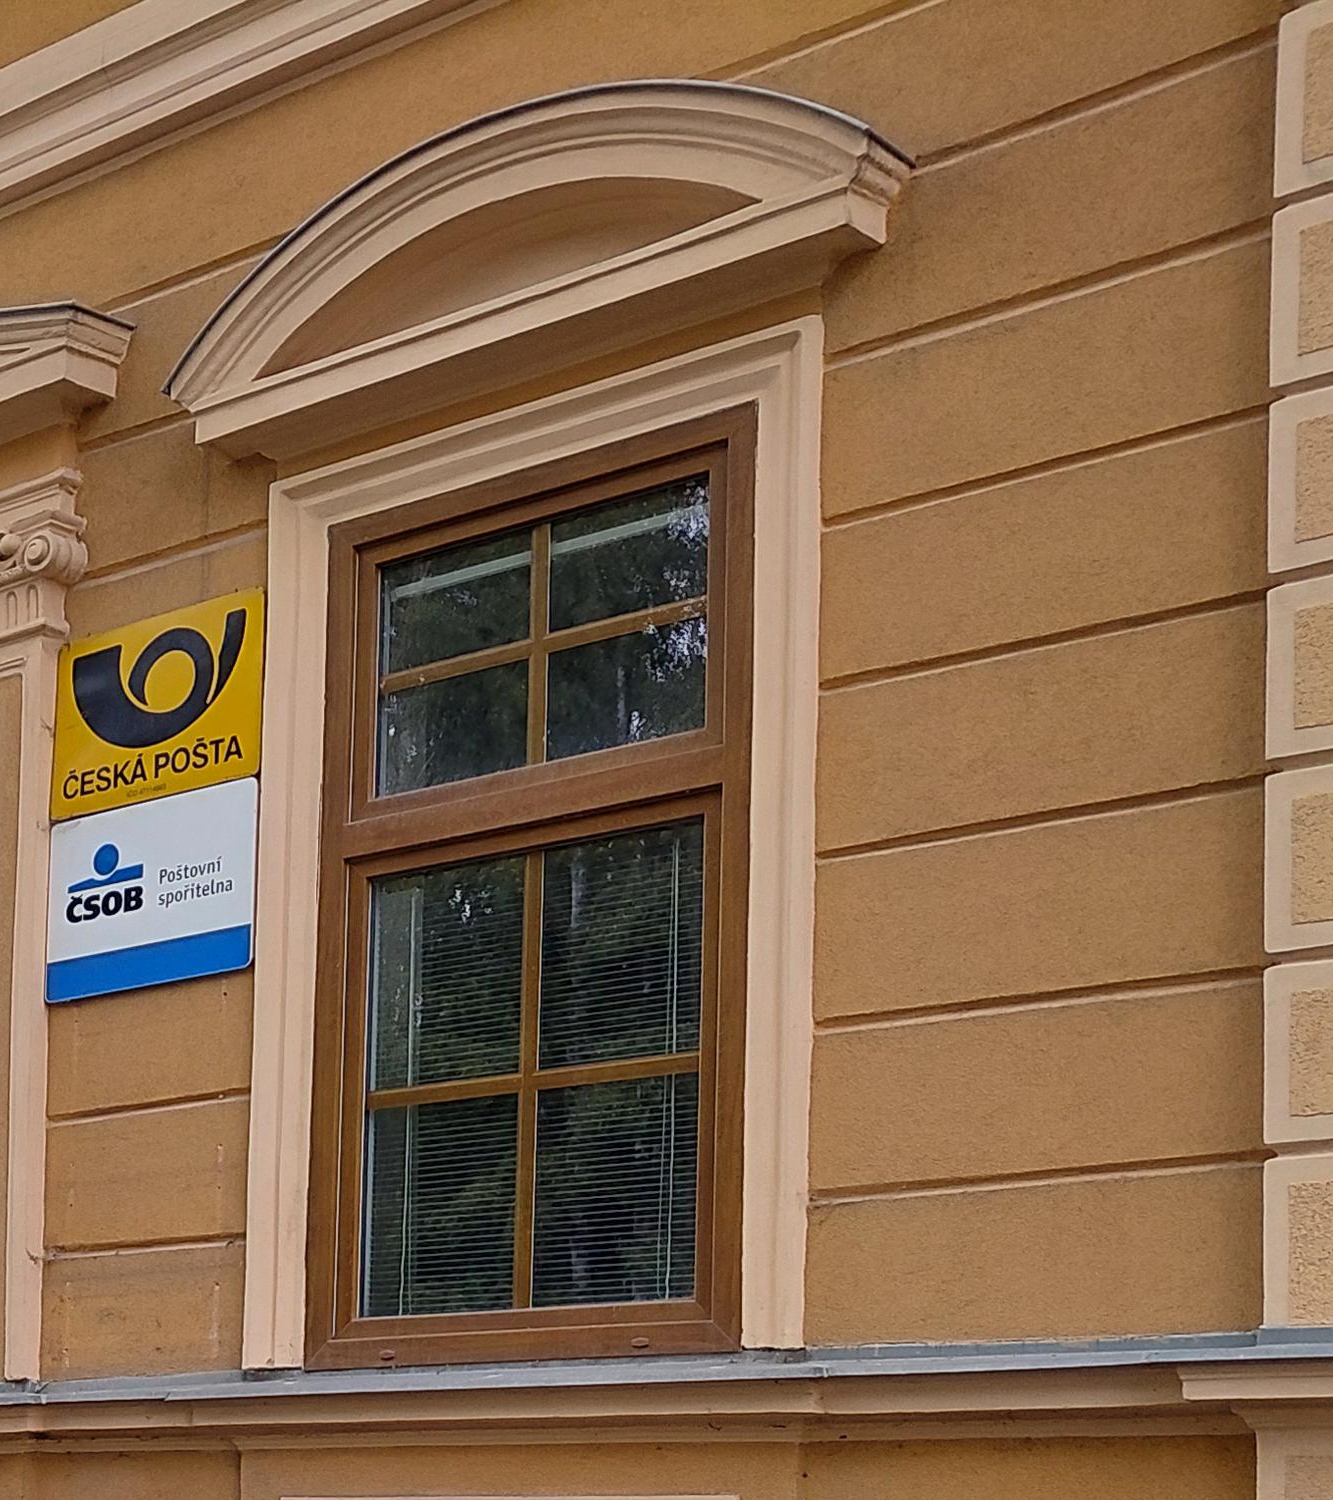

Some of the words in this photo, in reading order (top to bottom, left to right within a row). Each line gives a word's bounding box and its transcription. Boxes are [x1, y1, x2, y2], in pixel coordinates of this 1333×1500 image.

[62, 753, 148, 800] ČESKÁ
[153, 735, 244, 779] POŠTA
[158, 855, 223, 885] Poštovní
[65, 885, 144, 924] ČSOB
[157, 879, 234, 909] spořitelna
